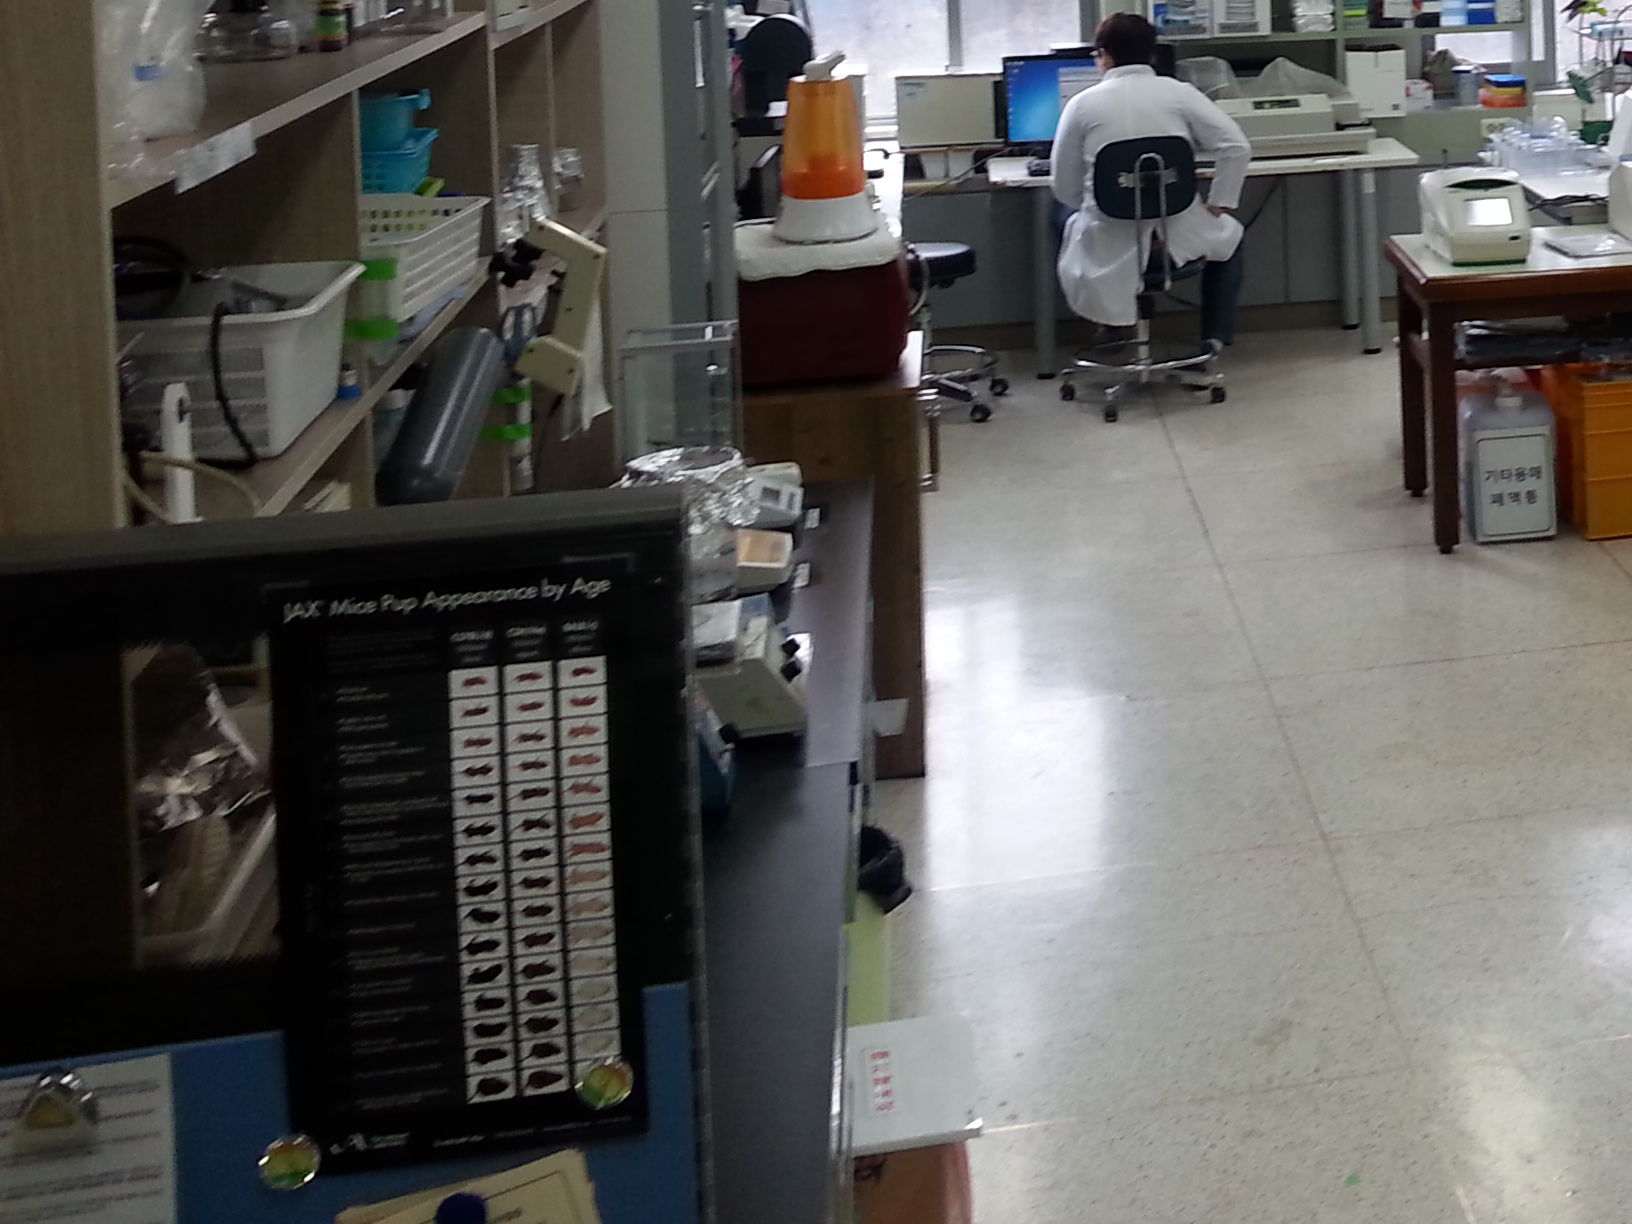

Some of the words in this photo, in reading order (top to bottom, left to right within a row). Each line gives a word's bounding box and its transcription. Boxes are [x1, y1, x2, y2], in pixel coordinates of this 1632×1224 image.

[1486, 466, 1542, 483] 기타용매
[328, 596, 378, 618] Mice
[381, 593, 419, 615] Pup
[421, 585, 539, 613] Appearance
[540, 577, 567, 602] by
[570, 576, 613, 600] Age
